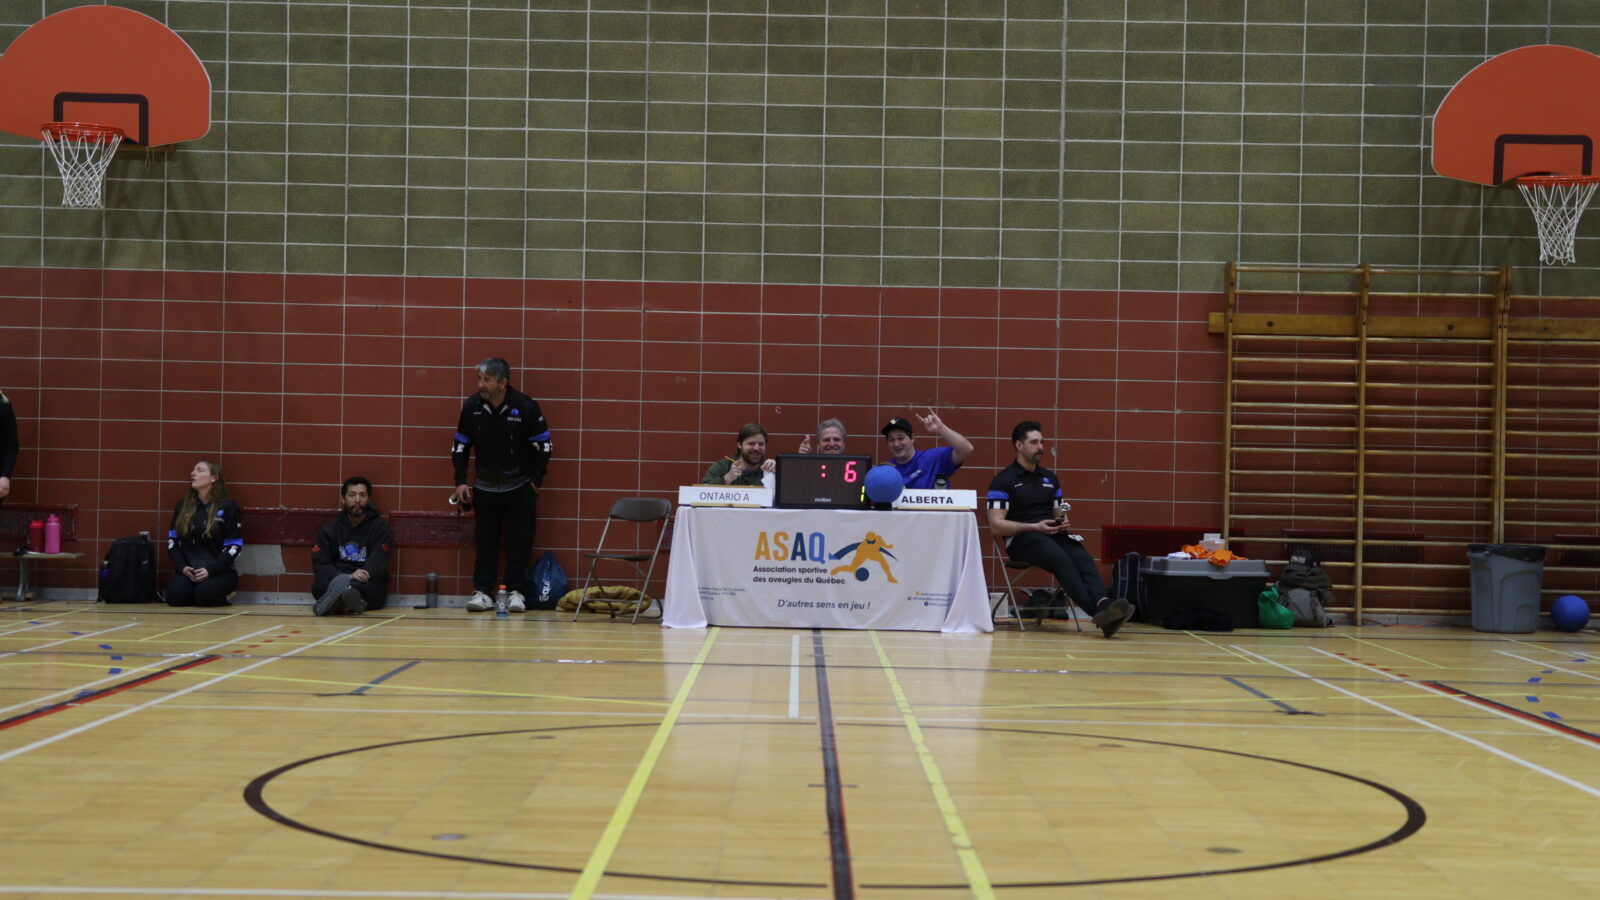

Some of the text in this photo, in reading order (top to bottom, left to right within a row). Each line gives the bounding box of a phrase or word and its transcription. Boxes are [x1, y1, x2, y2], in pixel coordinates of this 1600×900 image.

[844, 461, 857, 483] 6
[699, 491, 750, 501] ONTARIO A
[901, 495, 954, 504] ALBERTA
[754, 531, 826, 565] ASAQ
[798, 567, 828, 575] sportive
[768, 577, 803, 585] aveugles
[815, 577, 845, 585] Québec
[777, 599, 814, 608] D'autres
[850, 602, 865, 611] jeu
